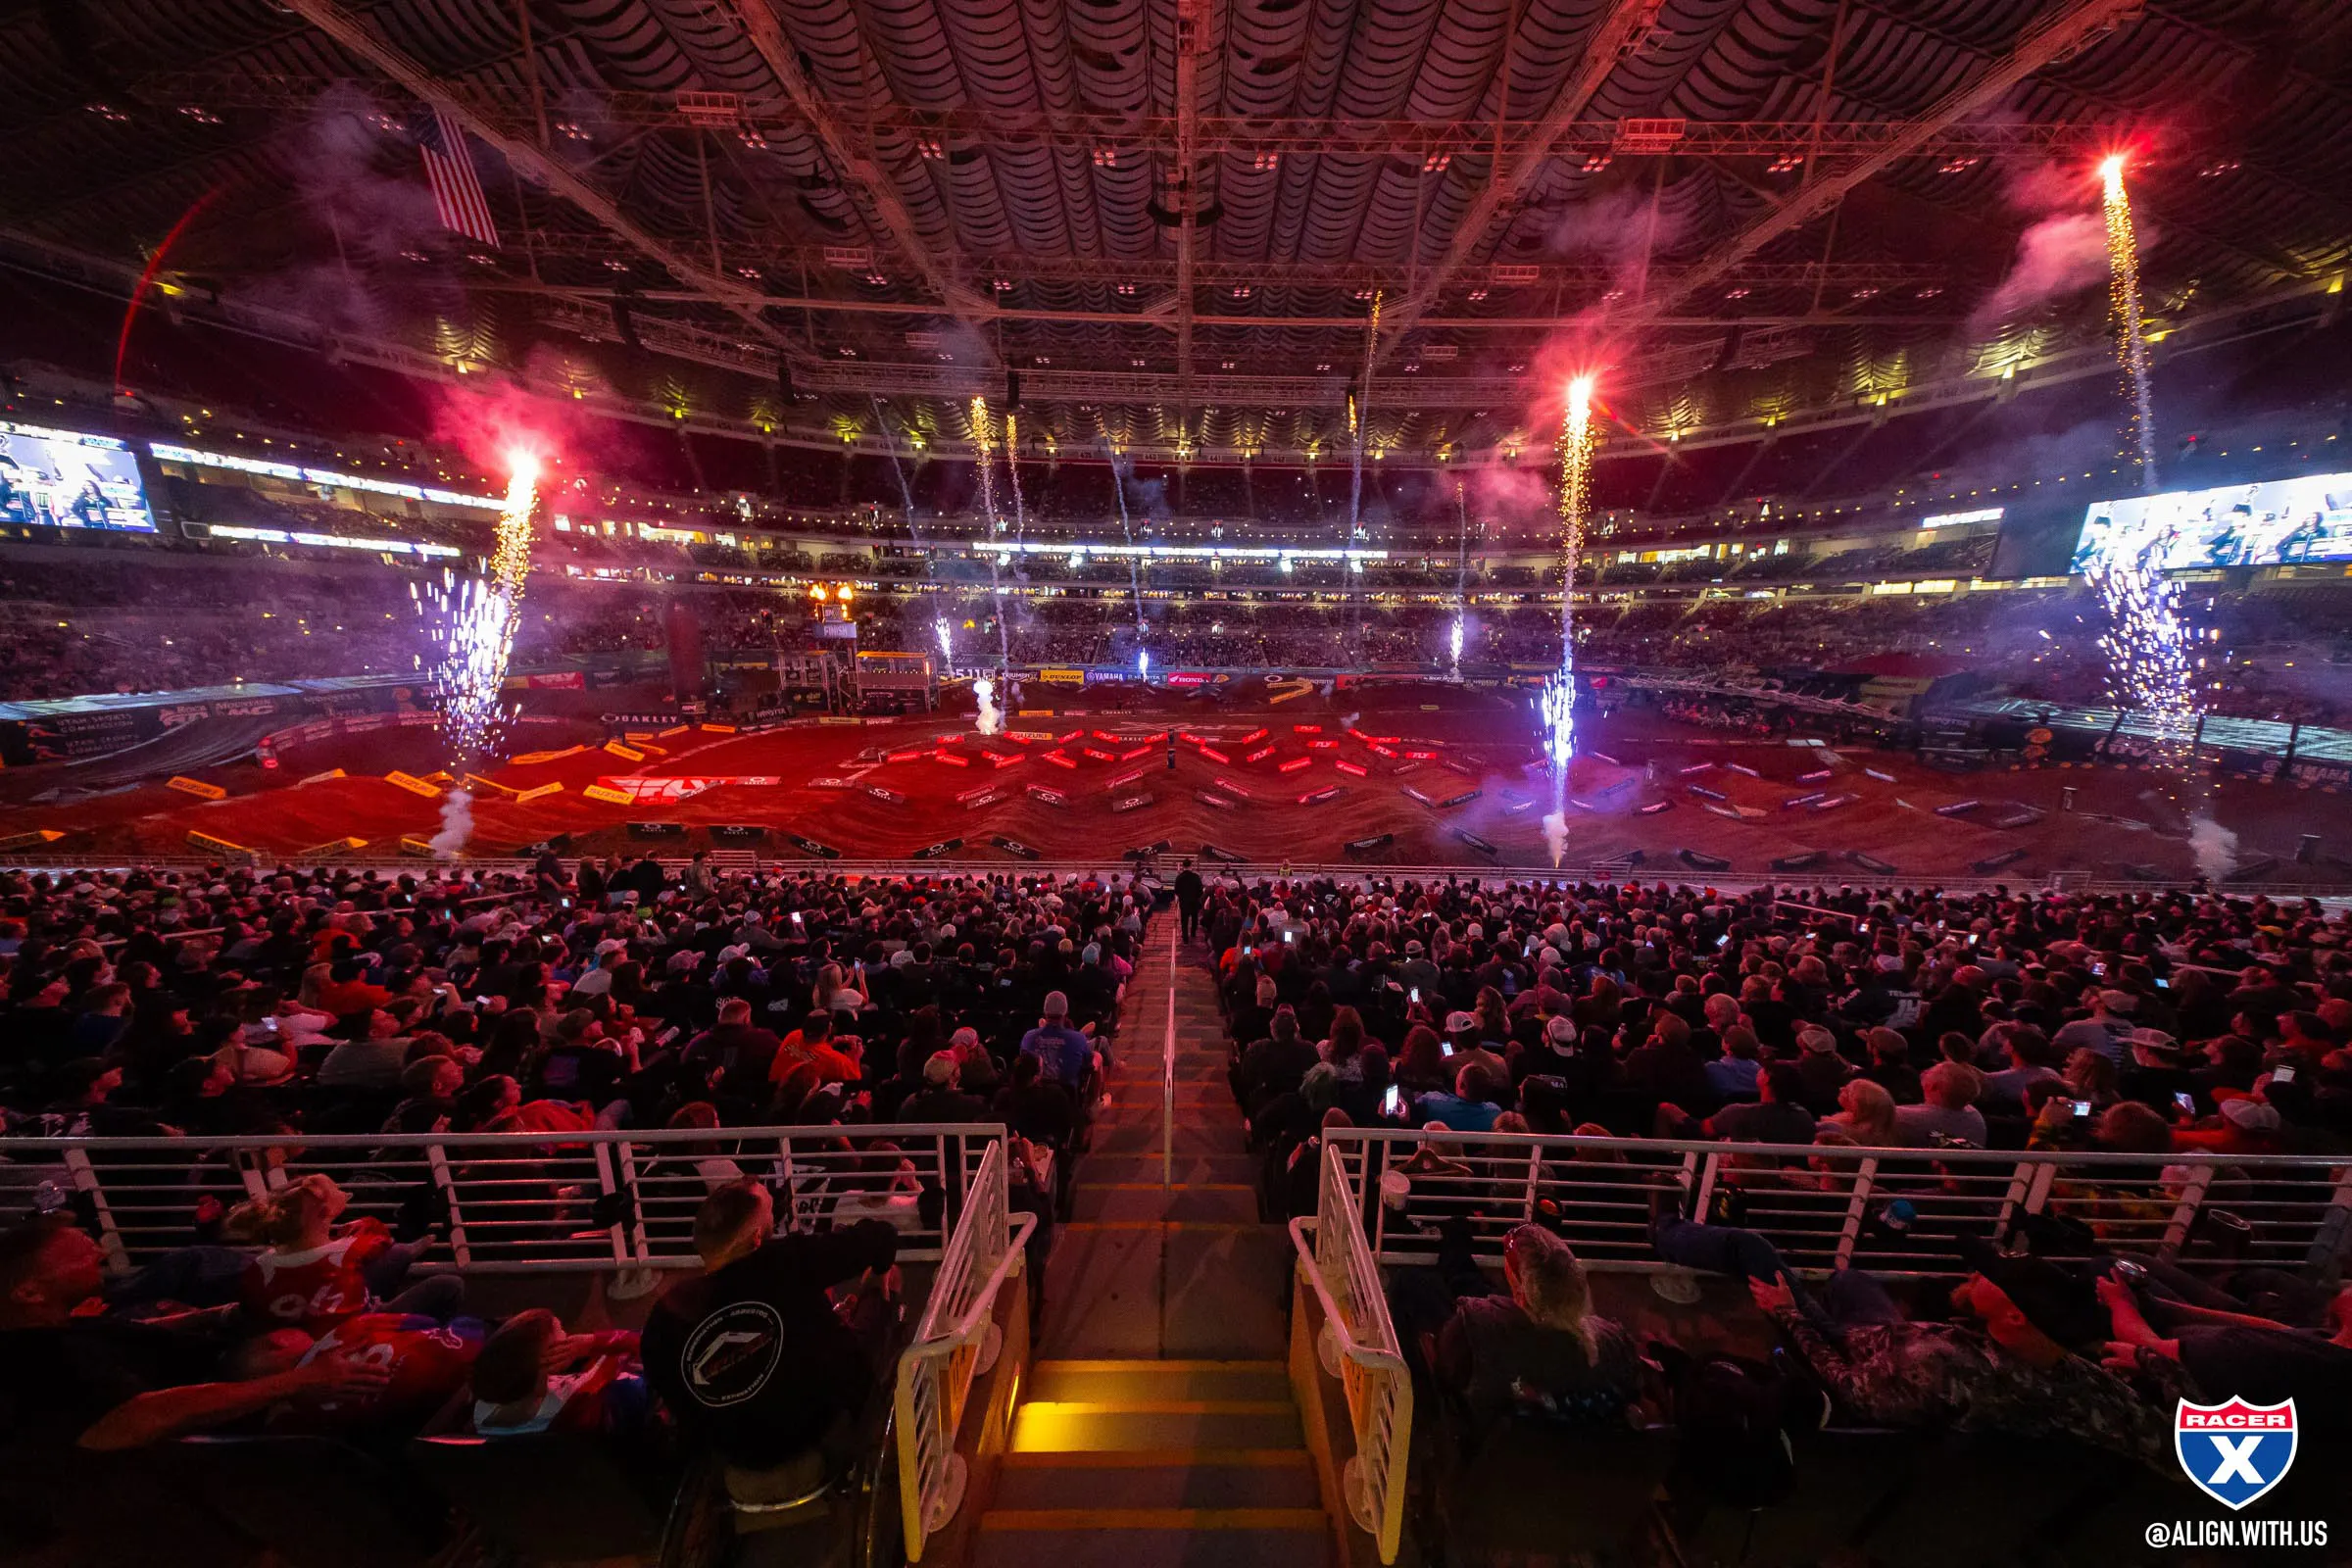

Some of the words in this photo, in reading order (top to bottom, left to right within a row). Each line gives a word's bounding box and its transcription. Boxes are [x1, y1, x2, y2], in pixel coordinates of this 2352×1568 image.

[824, 625, 848, 636] FINISH
[1095, 672, 1124, 681] YAMAHA
[589, 788, 631, 803] SUZUKI
